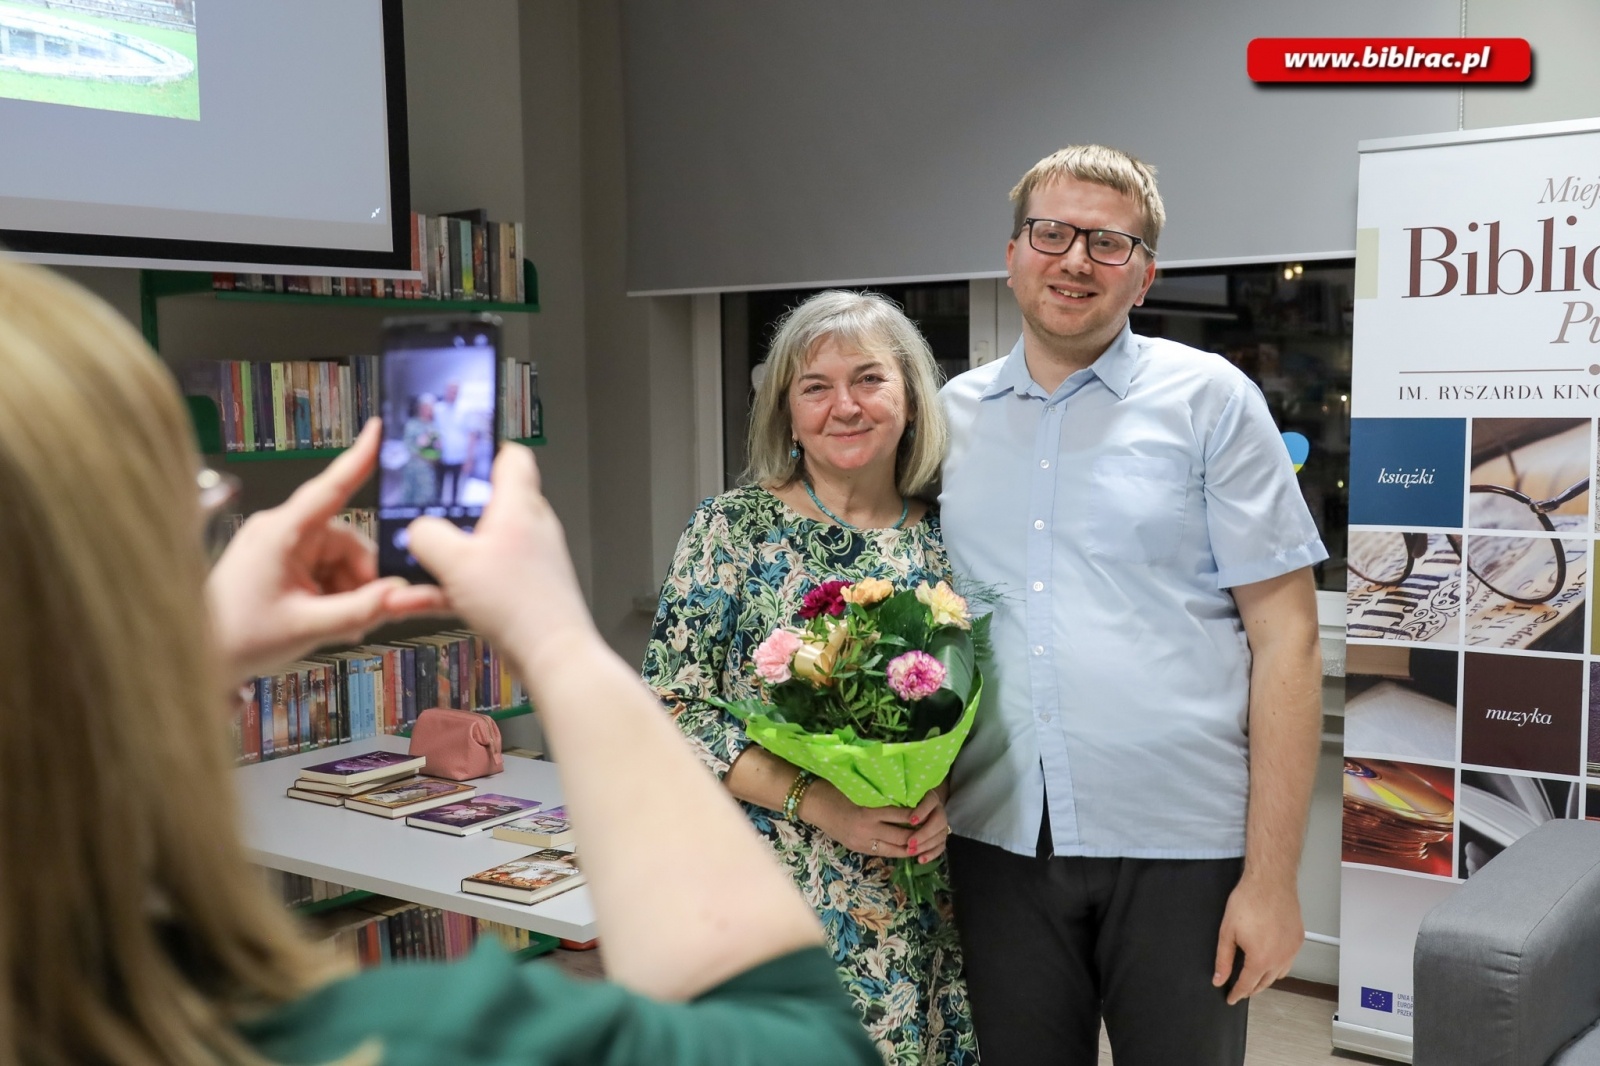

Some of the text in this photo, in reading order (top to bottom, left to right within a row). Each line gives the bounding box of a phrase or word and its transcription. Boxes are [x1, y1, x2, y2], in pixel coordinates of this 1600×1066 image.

[1399, 385, 1428, 401] IM.
[1438, 384, 1544, 401] RYSZARDA
[1377, 468, 1435, 488] książki
[1485, 708, 1553, 727] muzyka
